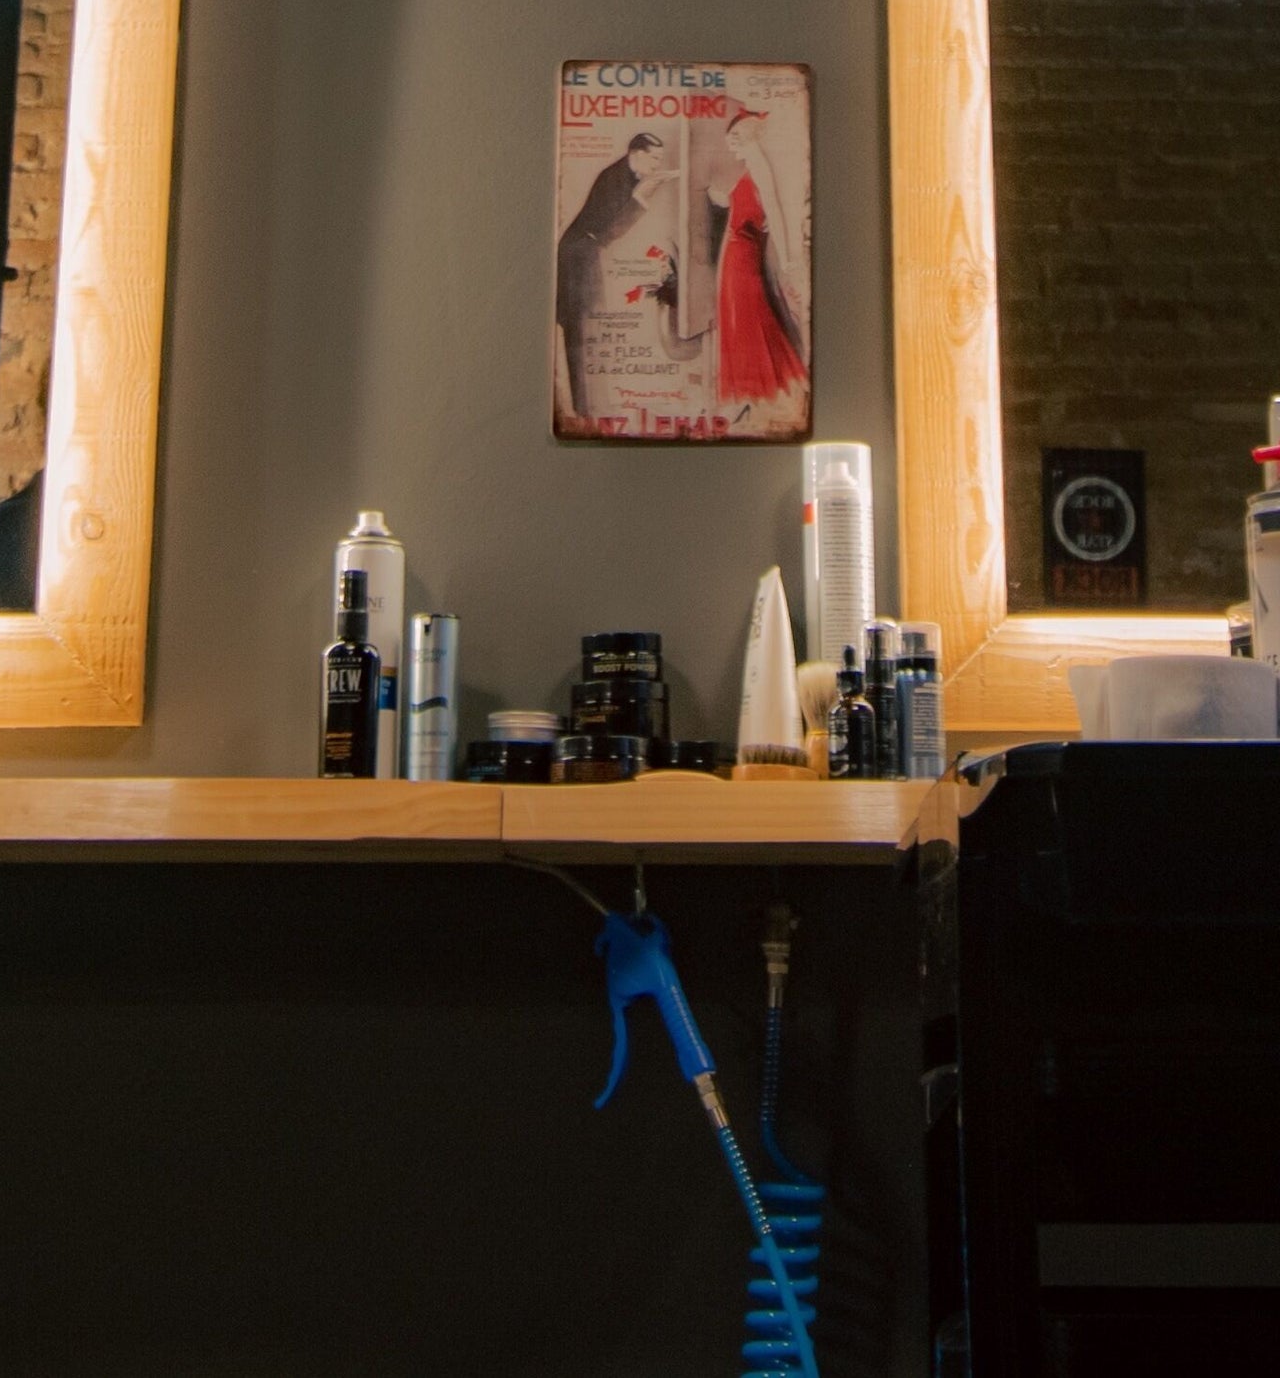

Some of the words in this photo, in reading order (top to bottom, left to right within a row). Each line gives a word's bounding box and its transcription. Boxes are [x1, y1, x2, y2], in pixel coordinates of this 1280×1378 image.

[599, 64, 696, 88] COMTE
[702, 70, 726, 88] DE
[561, 90, 728, 127] LUXEMBOURG
[328, 668, 362, 693] REW
